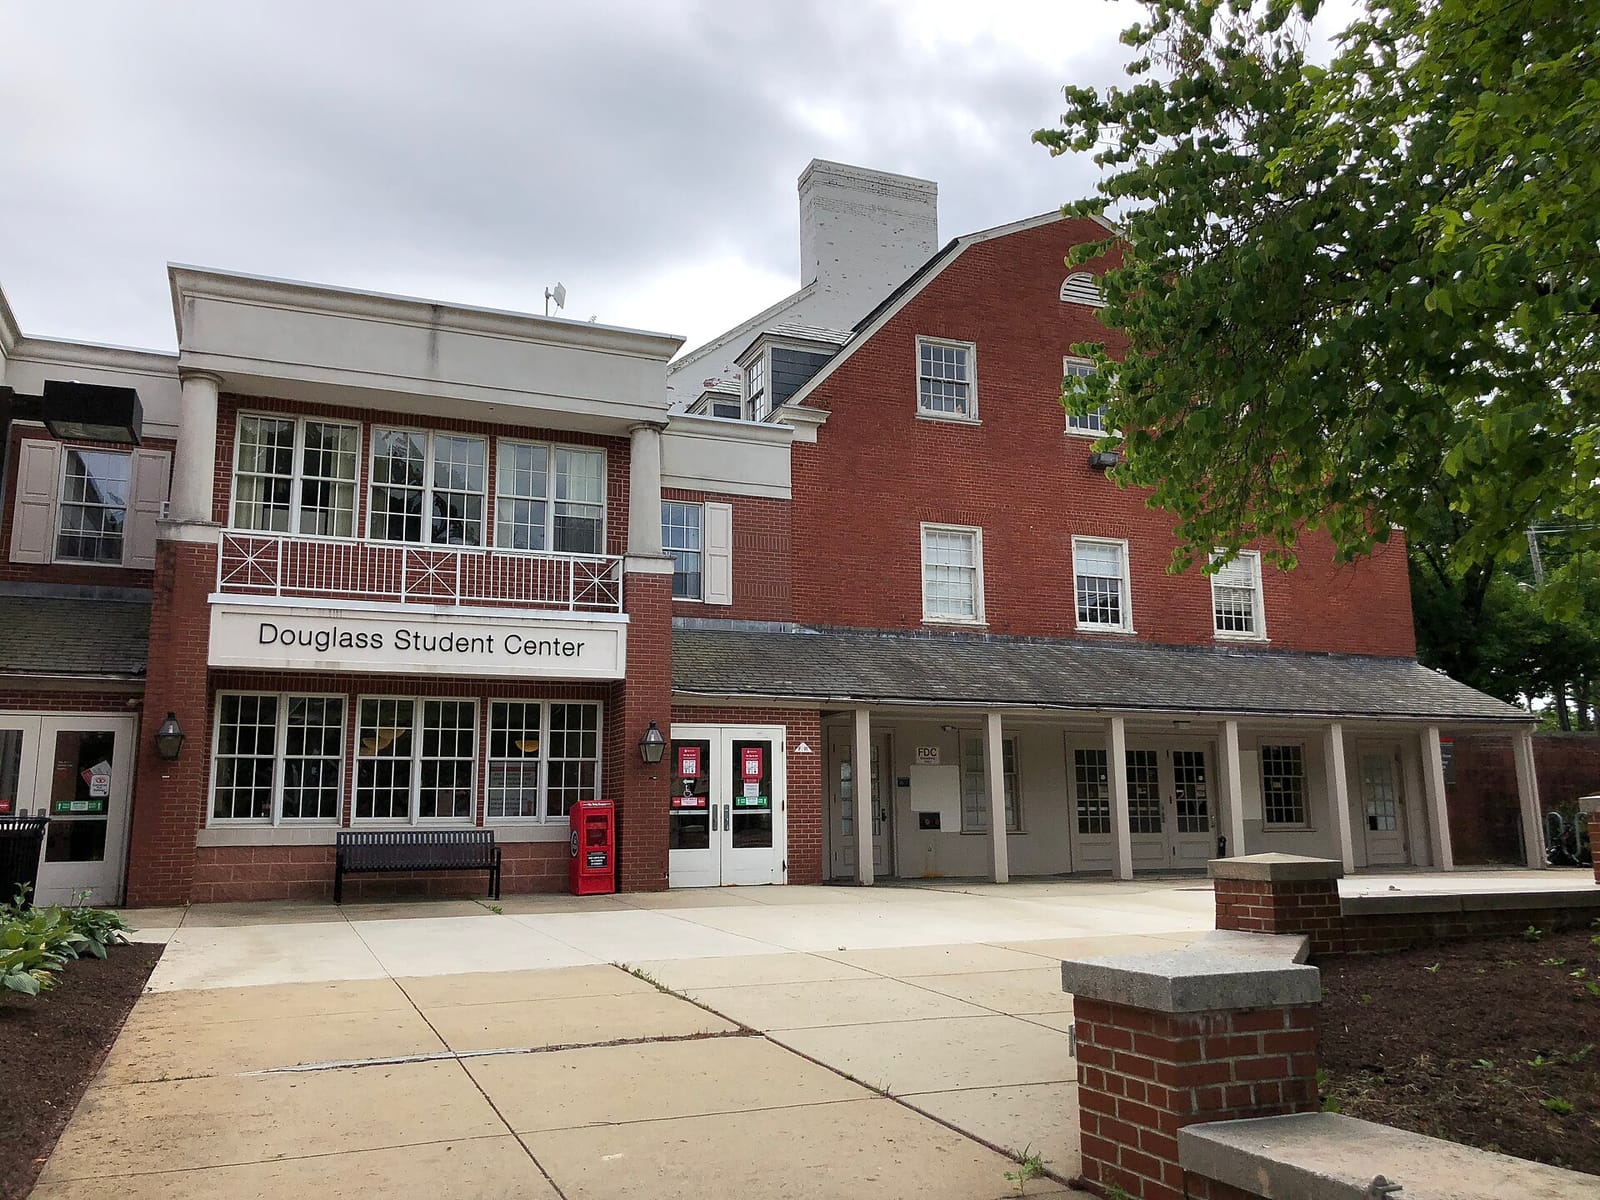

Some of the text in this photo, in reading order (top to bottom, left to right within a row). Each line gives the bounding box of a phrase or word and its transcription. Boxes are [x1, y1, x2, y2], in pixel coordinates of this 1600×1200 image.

[258, 623, 585, 657] Douglass Student Center
[918, 747, 937, 757] FDC
